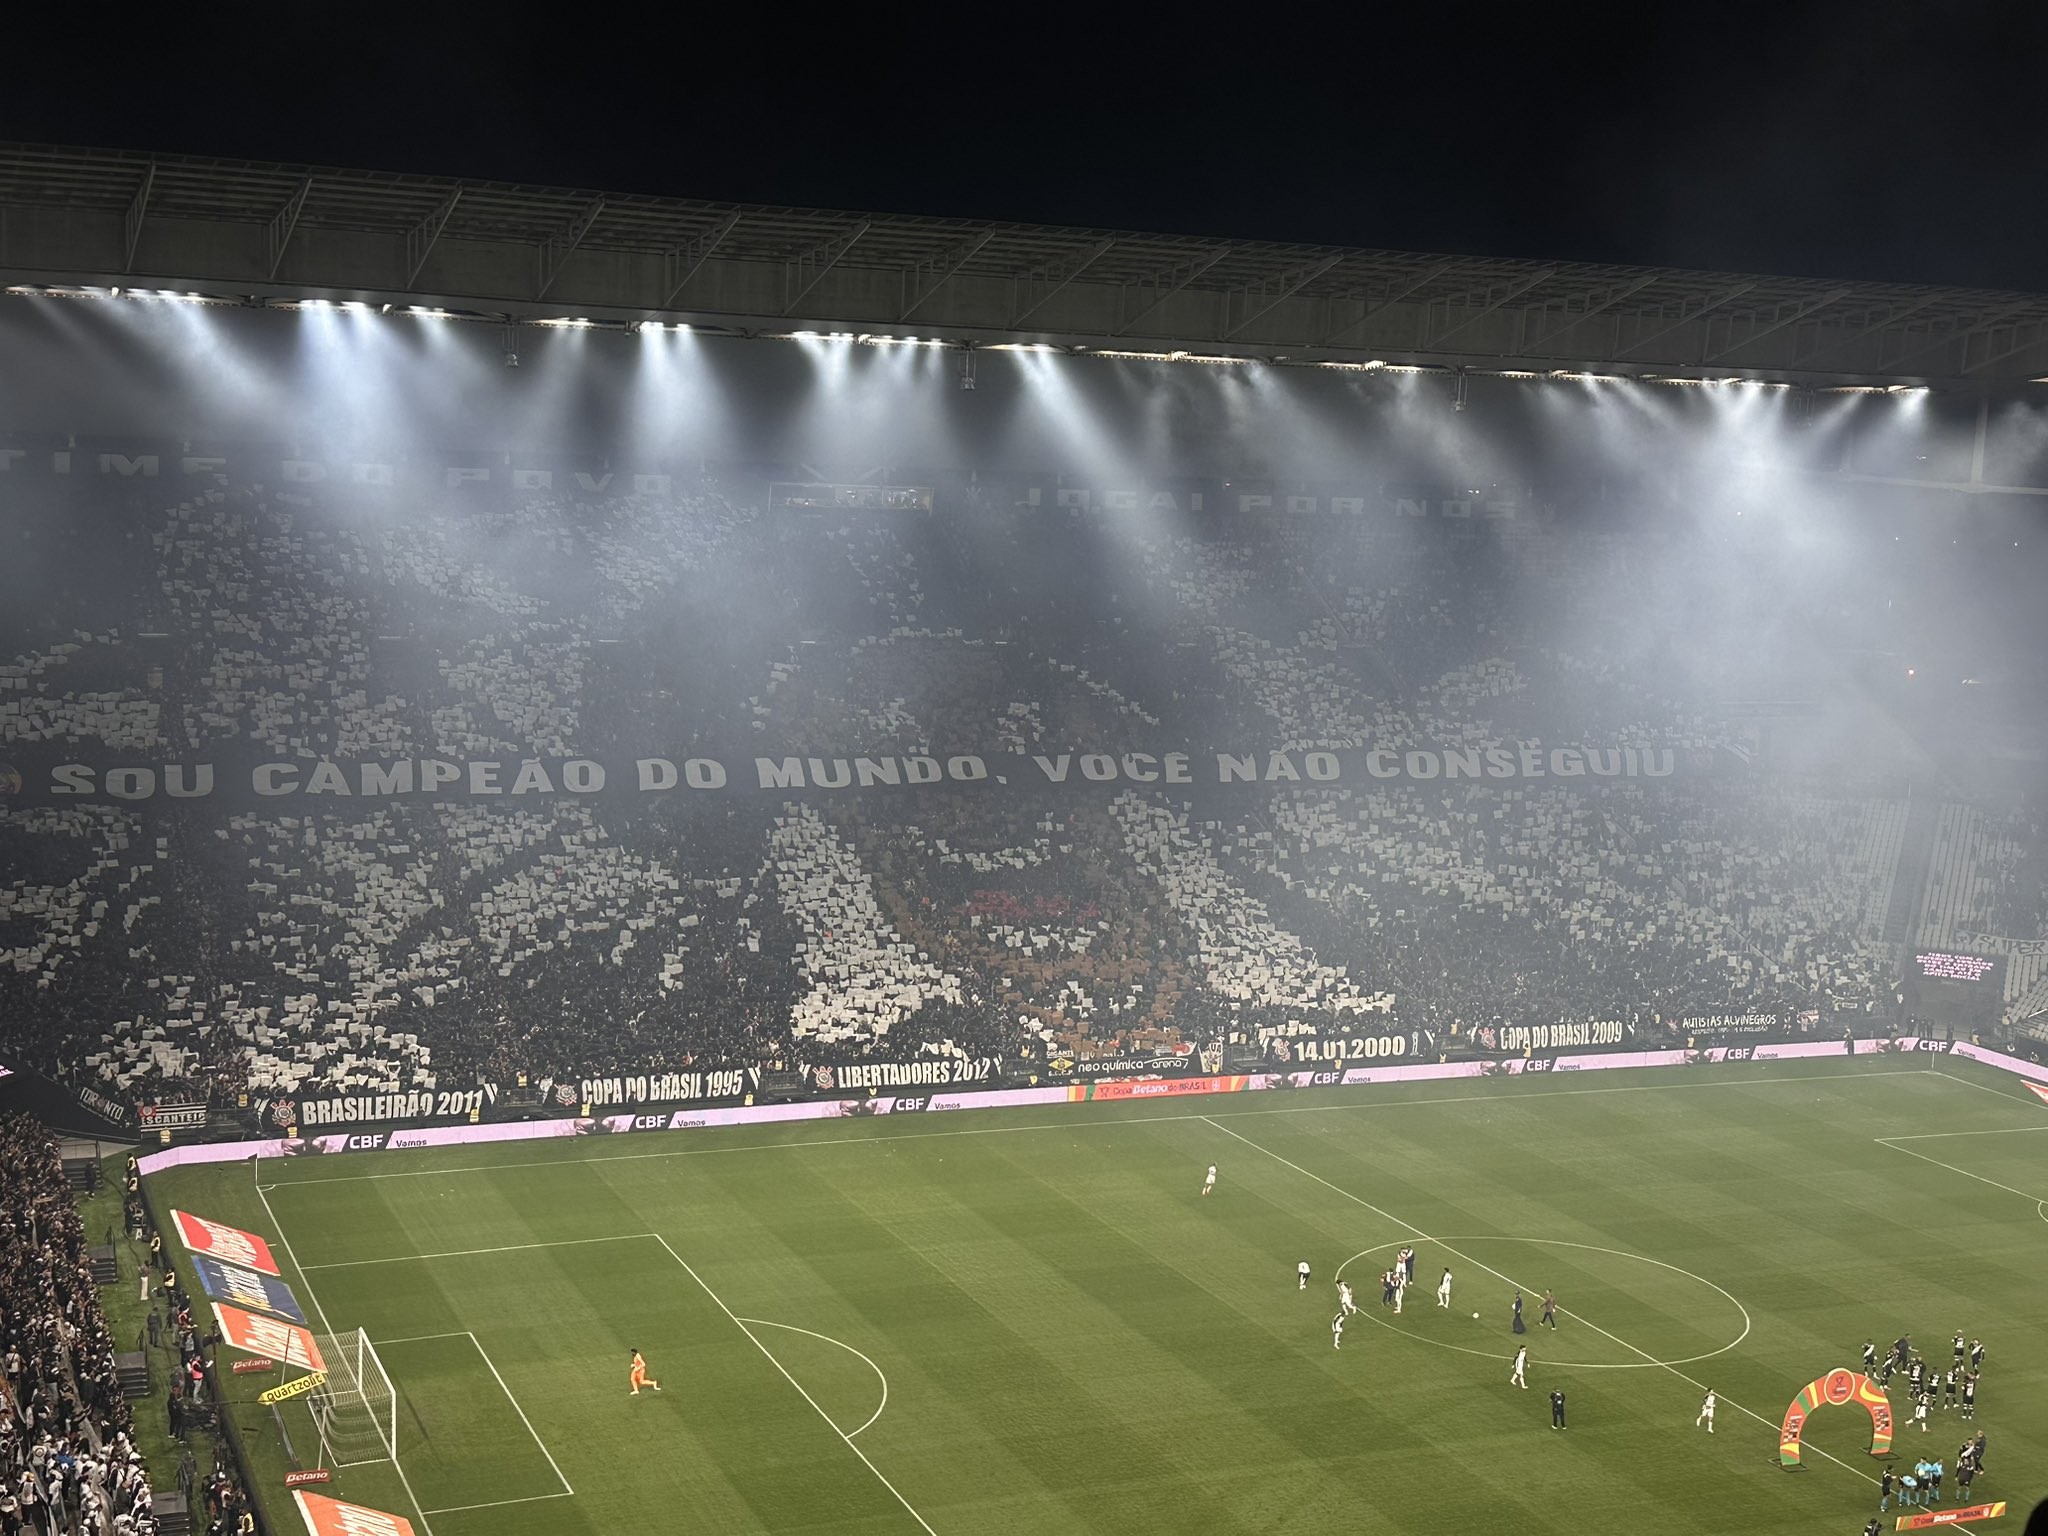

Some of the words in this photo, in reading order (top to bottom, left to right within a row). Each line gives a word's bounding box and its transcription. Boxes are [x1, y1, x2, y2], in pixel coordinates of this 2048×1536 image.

[50, 763, 214, 800] SOU
[252, 757, 606, 796] CAMPEÃO
[636, 757, 727, 791] DO
[1365, 749, 1675, 779] CONSEGUIU
[1500, 1026, 1531, 1050] COPA
[1533, 1025, 1548, 1049] DO
[1551, 1022, 1590, 1047] BRASIL
[1592, 1020, 1623, 1044] 2009
[1294, 1035, 1406, 1062] 14.01.2000
[1919, 1040, 1947, 1052] CBF
[1728, 1049, 1750, 1060] CBF
[1078, 1062, 1100, 1073] neo
[1102, 1059, 1144, 1073] química
[1526, 1060, 1551, 1071] CBF
[837, 1061, 950, 1089] LIBERTADORES
[952, 1057, 991, 1082] 2012
[1314, 1072, 1340, 1084] CBF
[582, 1077, 626, 1106] COPA
[705, 1069, 744, 1097] 1995
[302, 1089, 433, 1125] BRASILEIRÃO
[437, 1090, 484, 1115] 2011
[896, 1098, 925, 1111] CBF
[934, 1102, 961, 1110] Vamos
[635, 1115, 667, 1129] CBF
[349, 1134, 384, 1149] CBF
[267, 1373, 322, 1403] quartzolit
[286, 1472, 328, 1483] Betano
